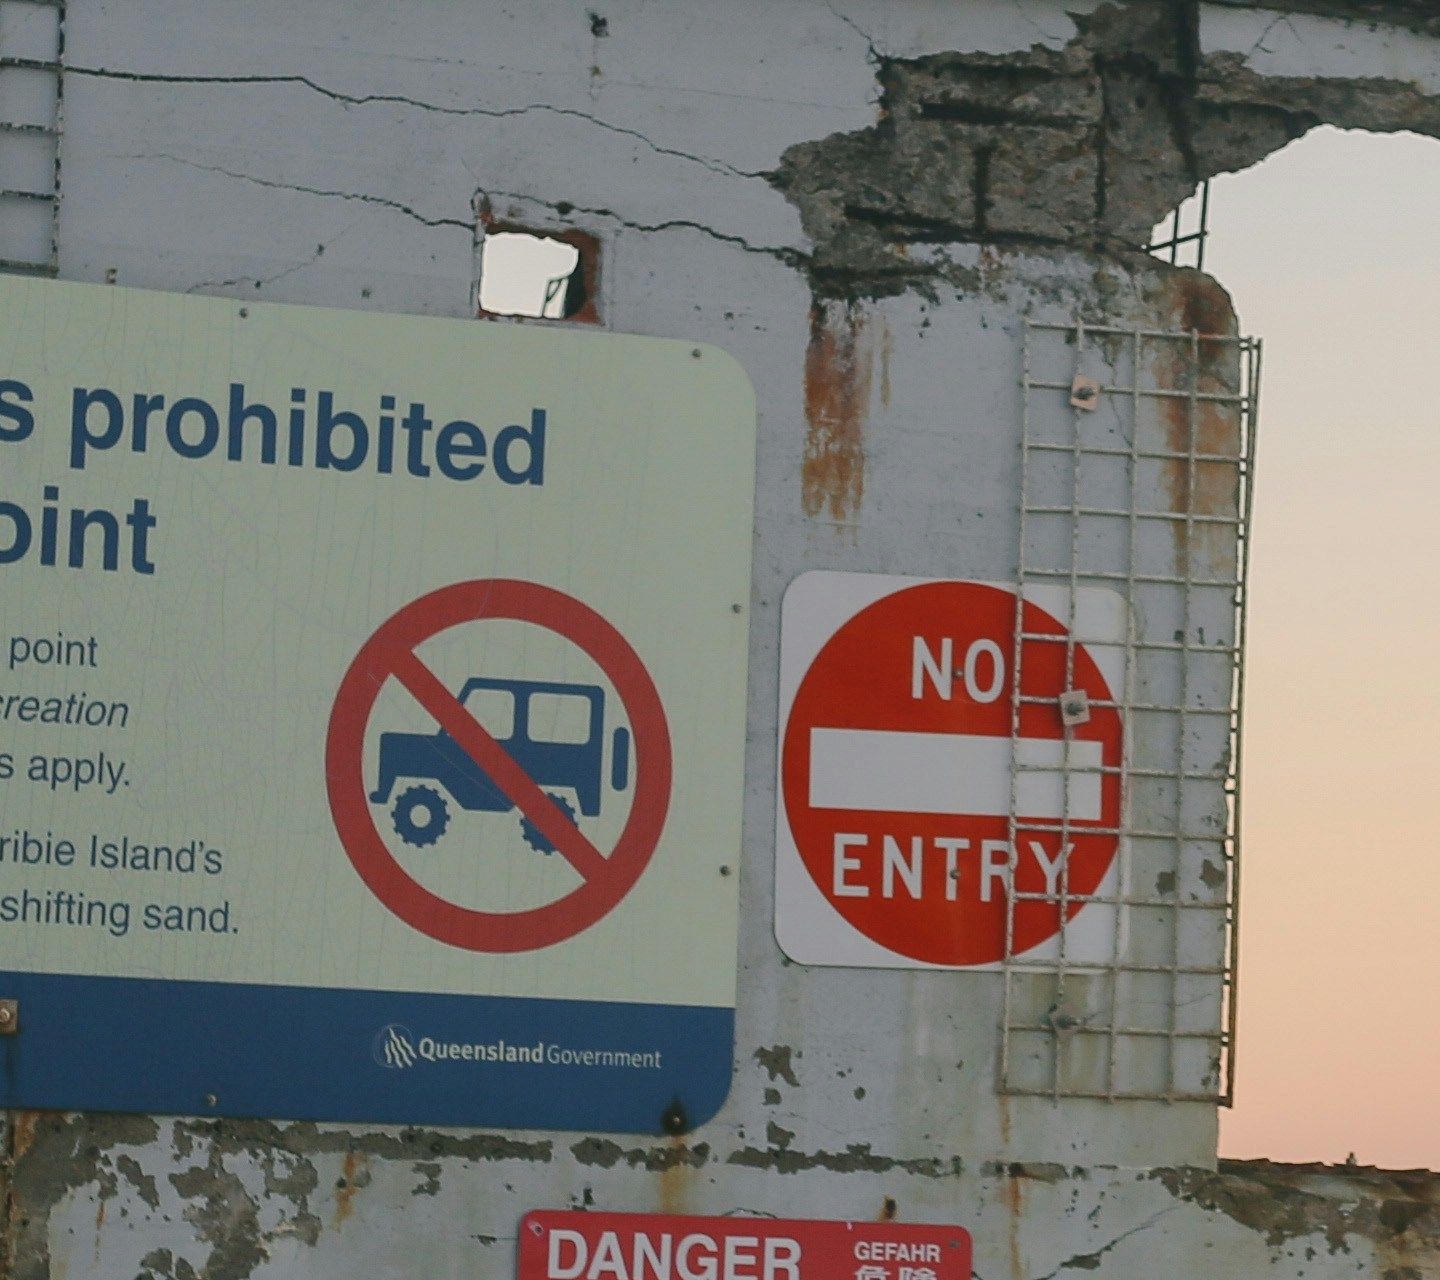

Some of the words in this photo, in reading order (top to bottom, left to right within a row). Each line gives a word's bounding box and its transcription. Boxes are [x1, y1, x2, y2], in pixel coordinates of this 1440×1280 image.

[69, 383, 546, 486] prohibited
[9, 632, 97, 668] point
[911, 636, 1005, 703] NO
[28, 752, 131, 794] apply.
[833, 833, 1075, 905] ENTRY
[0, 890, 130, 936] shifting
[143, 902, 238, 934] sand.
[419, 1037, 544, 1063] Queensland
[547, 1045, 662, 1068] Government
[854, 1241, 941, 1263] GEFAHR
